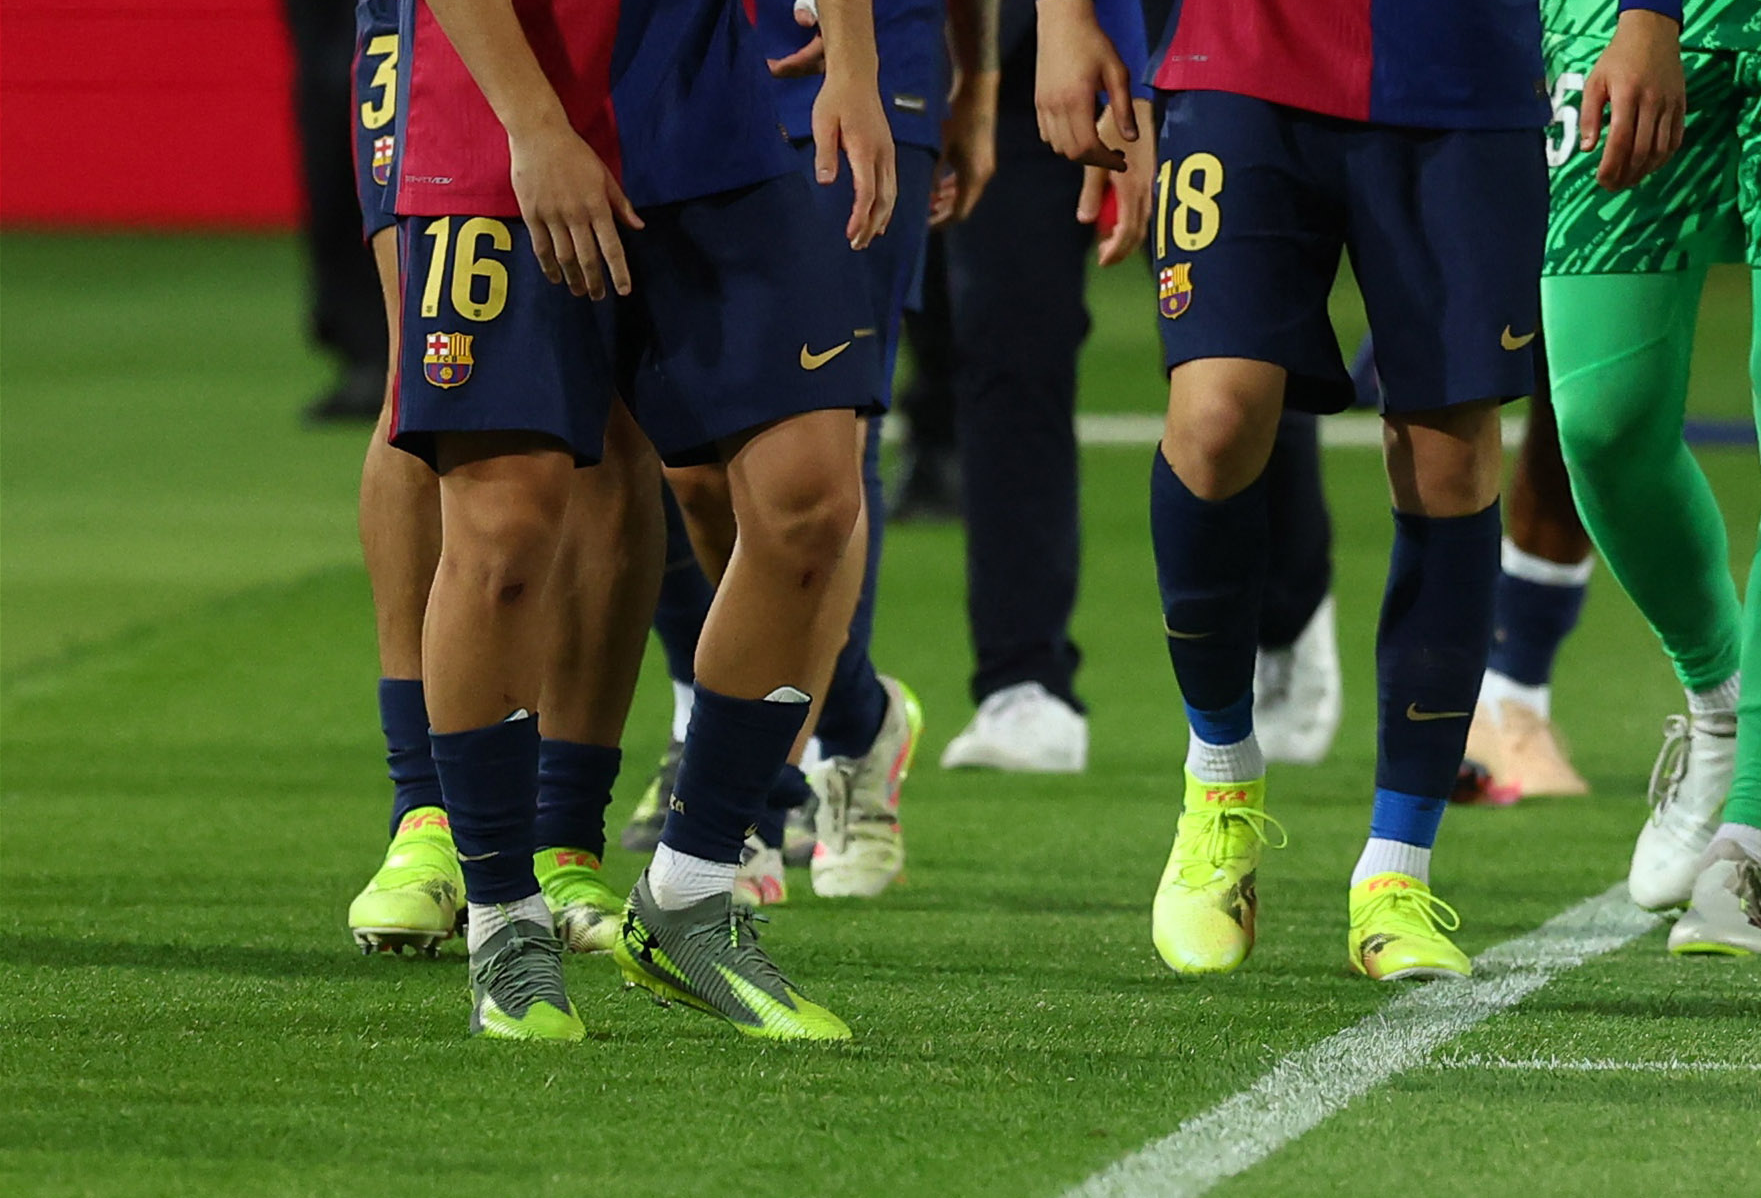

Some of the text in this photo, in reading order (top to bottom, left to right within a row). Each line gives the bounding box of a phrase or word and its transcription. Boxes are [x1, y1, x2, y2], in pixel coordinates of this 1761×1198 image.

[1156, 152, 1224, 260] 18
[421, 216, 512, 322] 16
[436, 354, 458, 363] FCB
